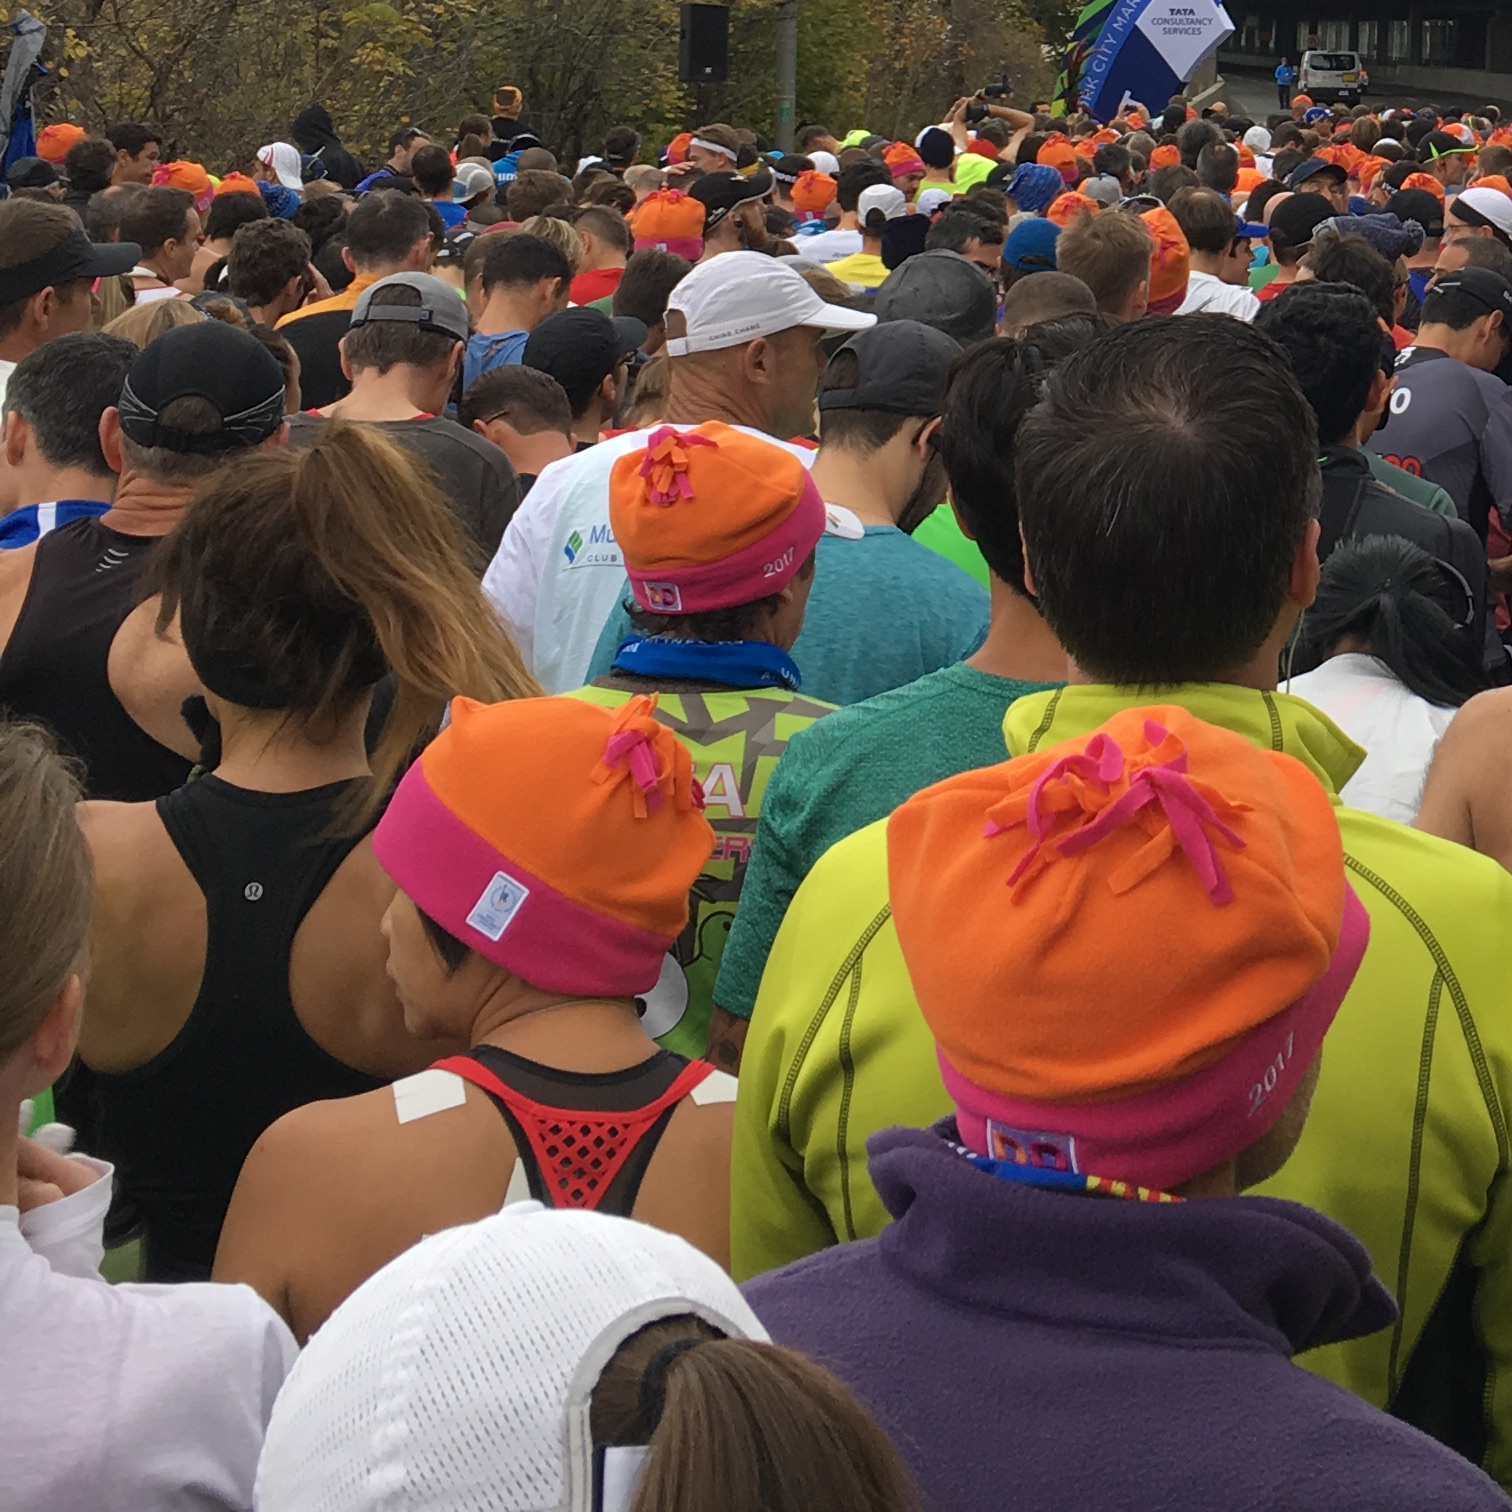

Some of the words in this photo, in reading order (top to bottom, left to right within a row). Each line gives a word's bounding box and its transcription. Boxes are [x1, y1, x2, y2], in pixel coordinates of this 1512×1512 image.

[1168, 8, 1196, 16] TATA
[1151, 17, 1213, 26] CONSULTANCY
[1162, 27, 1202, 36] SERVICES
[1092, 32, 1117, 72] CITY
[587, 554, 618, 563] CLUB
[762, 546, 796, 578] 2017
[1248, 1031, 1295, 1118] 2017
